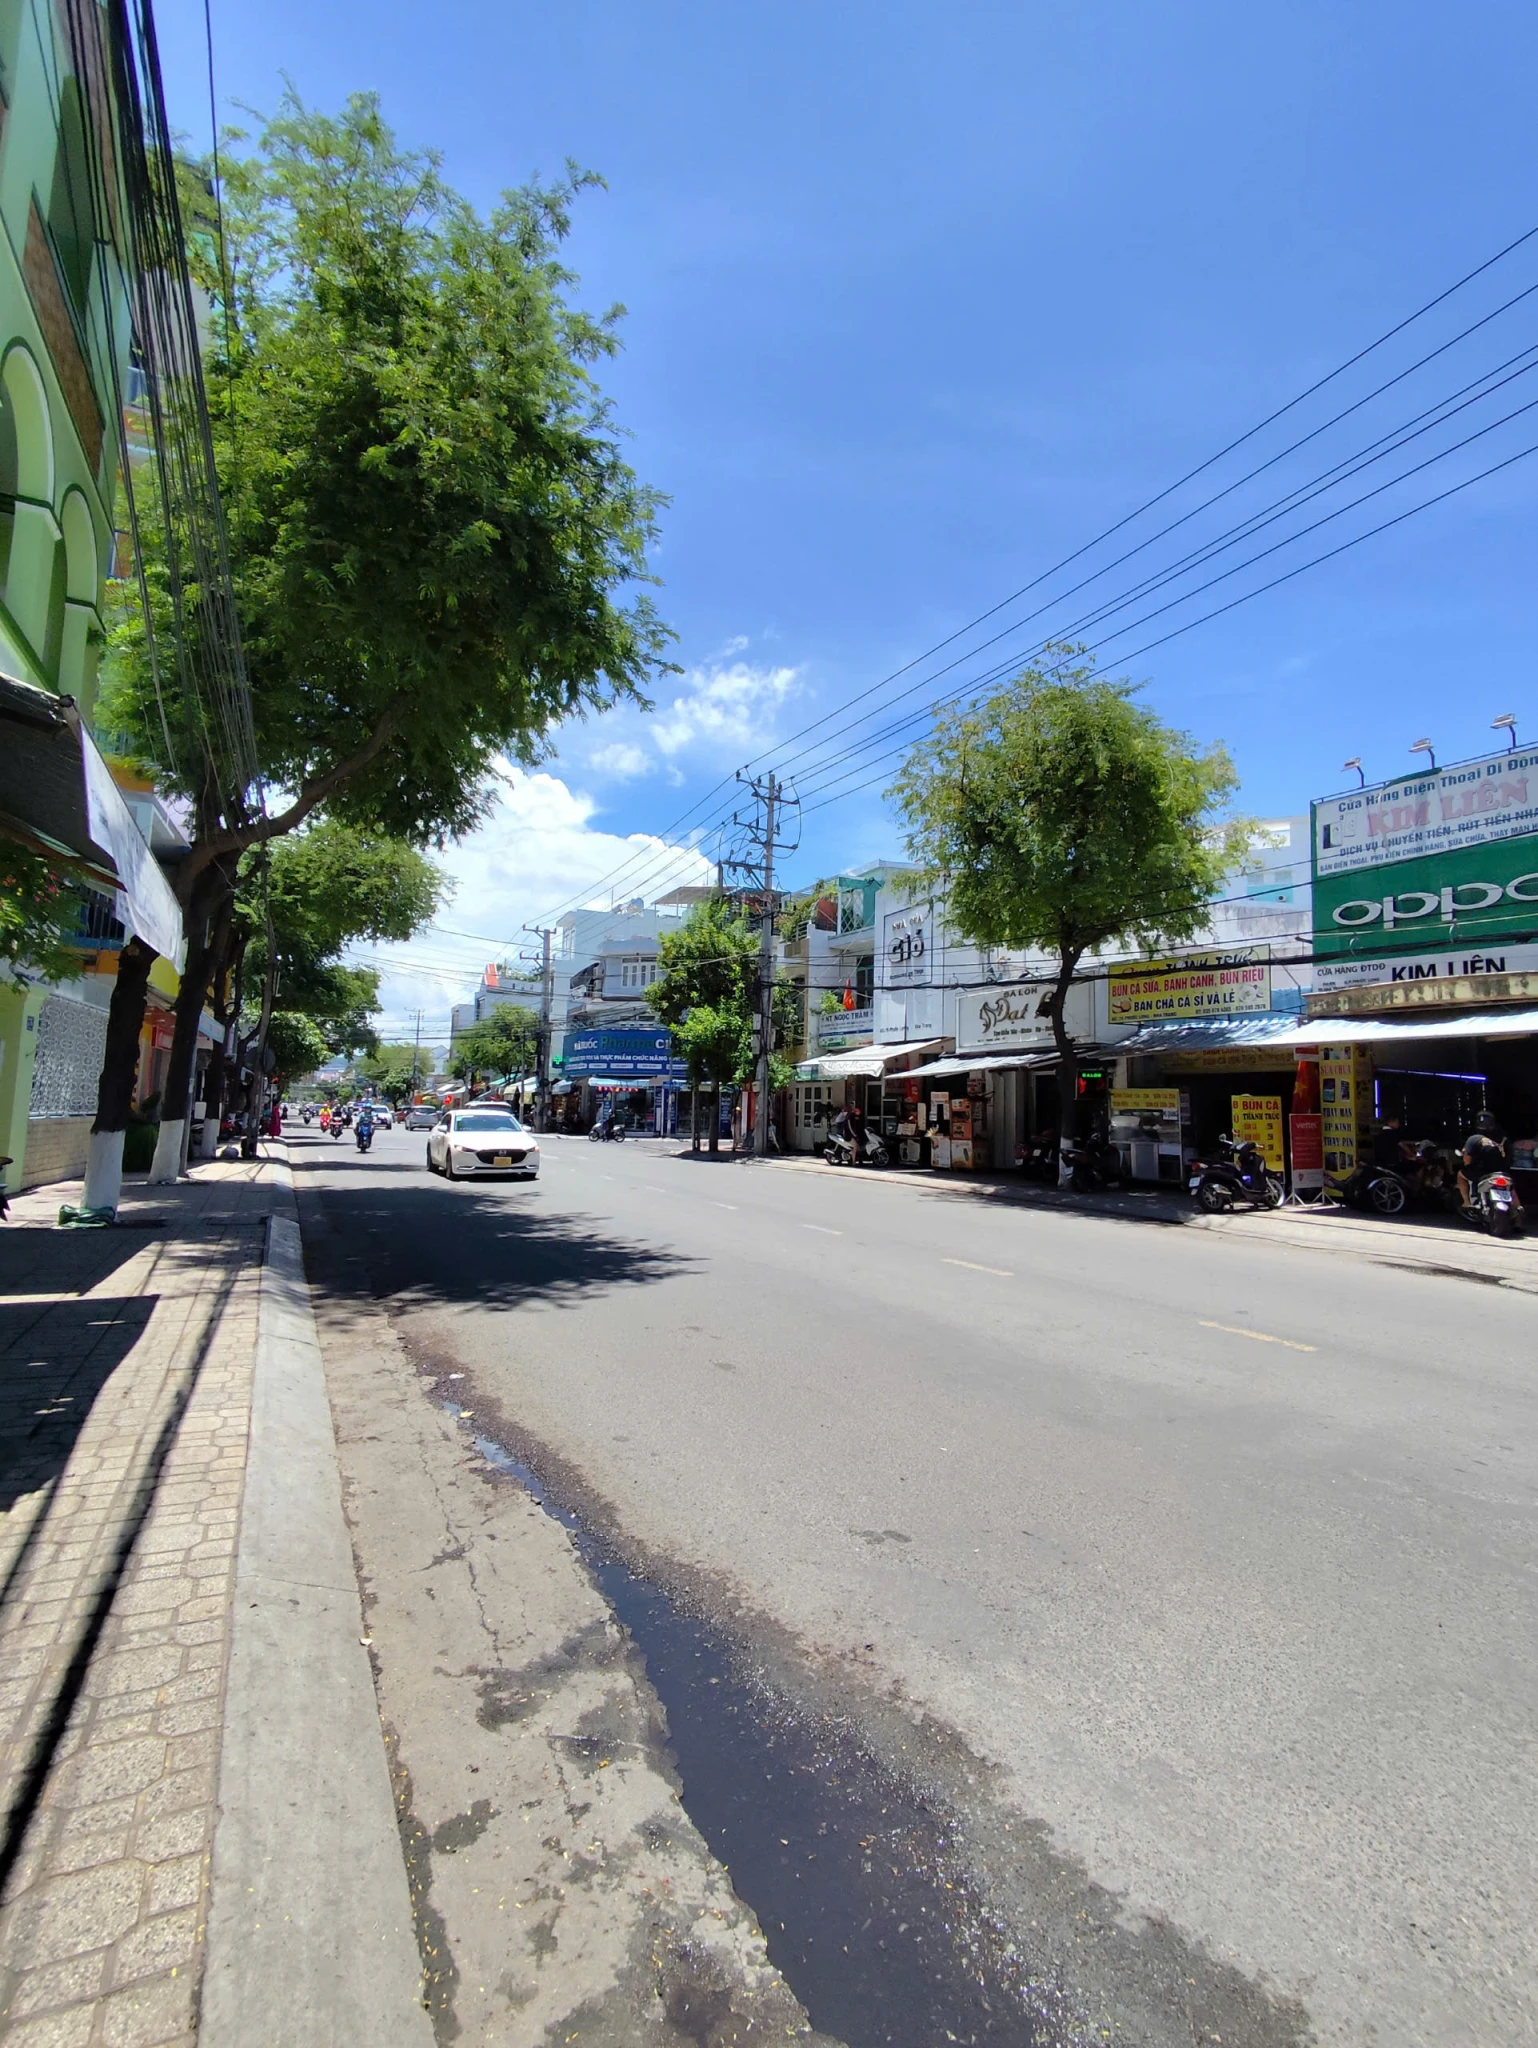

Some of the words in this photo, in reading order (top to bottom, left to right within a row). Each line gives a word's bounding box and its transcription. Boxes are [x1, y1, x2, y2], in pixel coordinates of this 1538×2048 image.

[1404, 781, 1435, 797] Điện
[1440, 768, 1481, 787] Thoại
[1487, 762, 1502, 777] Di
[1367, 801, 1430, 838] KIM
[1440, 777, 1529, 820] LIÊN
[1317, 967, 1332, 977] CỬA
[1335, 964, 1358, 974] HÀNG
[1392, 964, 1437, 981] KIM
[1003, 987, 1038, 998] SALON
[1130, 980, 1141, 995] CÁ
[1164, 976, 1188, 992] BÁNH
[1156, 995, 1175, 1010] CHẢ
[1178, 993, 1191, 1008] CÁ
[1207, 991, 1220, 1006] VÀ
[1223, 988, 1236, 1004] LẺ
[1265, 1098, 1279, 1110] CÁ
[1342, 1136, 1353, 1147] PIN
